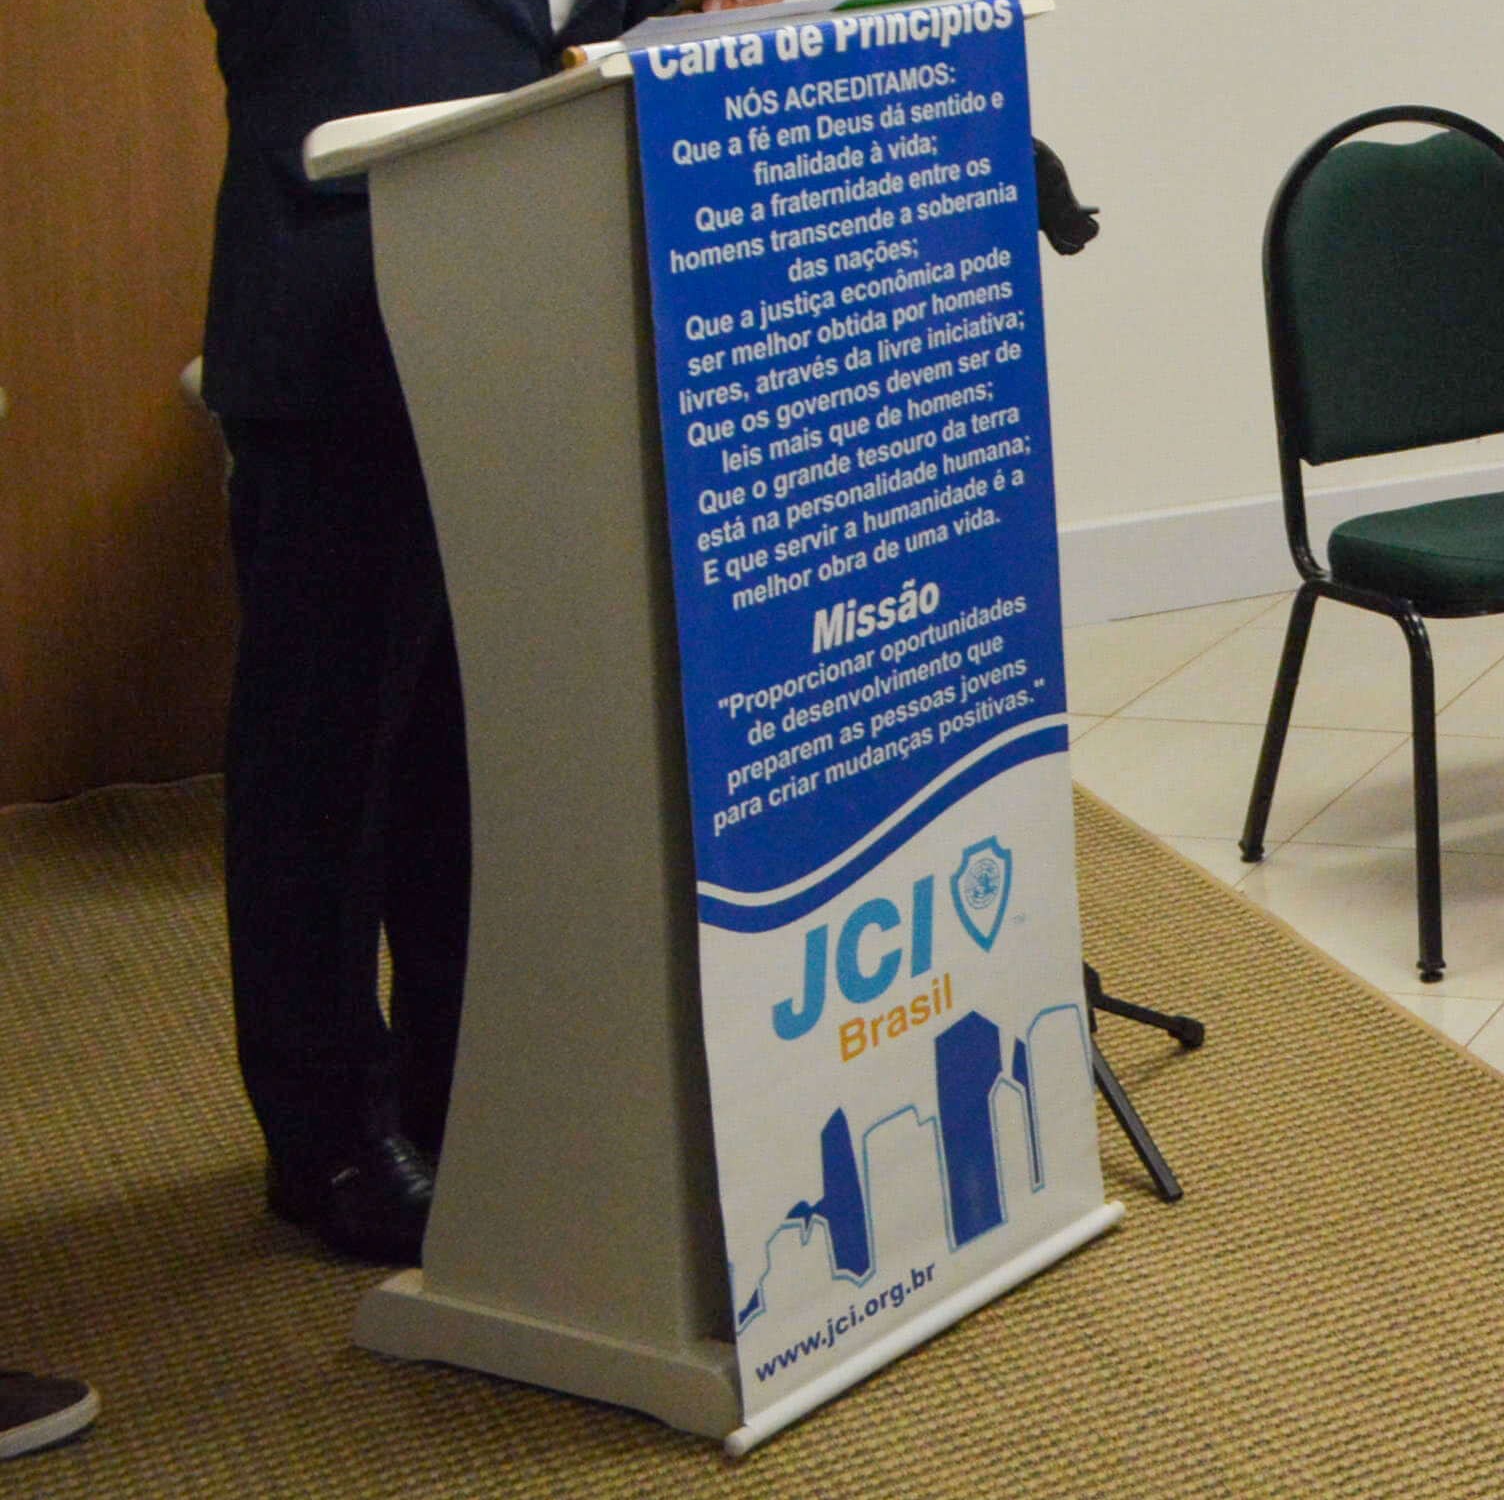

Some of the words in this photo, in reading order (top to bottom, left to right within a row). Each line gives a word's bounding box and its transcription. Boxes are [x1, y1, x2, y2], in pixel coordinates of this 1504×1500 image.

[650, 34, 764, 80] Carta
[776, 24, 823, 60] de
[725, 87, 779, 120] NÓS
[784, 62, 955, 111] ACREDITAMOS:
[672, 139, 721, 165] Que
[728, 136, 742, 156] a
[748, 125, 770, 152] fé
[777, 124, 811, 147] em
[816, 114, 875, 140] Deus
[880, 103, 906, 129] dá
[910, 90, 987, 123] sentido
[991, 91, 1004, 109] e
[753, 146, 864, 185] finalidade
[870, 141, 883, 164] à
[888, 133, 937, 160] vida;
[670, 237, 765, 274] homens
[770, 207, 895, 252] transcende
[900, 206, 913, 225] a
[916, 182, 1017, 221] soberania
[695, 206, 744, 232] Que
[751, 202, 765, 222] a
[770, 172, 904, 217] fraternidade
[908, 163, 961, 189] entre
[966, 157, 991, 177] os
[686, 314, 734, 341] Que
[740, 309, 754, 328] a
[760, 290, 835, 330] justiça
[841, 262, 955, 304] econômica
[960, 247, 1011, 282] pode
[788, 257, 828, 282] das
[834, 238, 919, 271] nações;
[679, 382, 749, 415] livres,
[756, 355, 838, 394] através
[844, 347, 872, 371] da
[878, 336, 922, 363] livre
[927, 310, 1024, 349] iniciativa;
[688, 350, 725, 376] ser
[732, 330, 811, 365] melhor
[817, 310, 887, 343] obtida
[892, 301, 927, 331] por
[931, 281, 1013, 315] homens
[687, 419, 735, 447] Que
[741, 410, 770, 432] os
[776, 380, 881, 429] governos
[886, 360, 953, 394] devem
[958, 350, 991, 373] ser
[995, 340, 1022, 363] de
[722, 444, 762, 473] leis
[769, 427, 823, 459] mais
[829, 417, 870, 446] que
[876, 405, 902, 429] de
[907, 382, 993, 420] homens;
[697, 515, 745, 552] está
[752, 511, 780, 533] na
[786, 461, 938, 529] personalidade
[943, 435, 1031, 474] humana;
[698, 486, 745, 515] Que
[752, 480, 767, 499] o
[773, 453, 851, 499] grande
[856, 430, 937, 469] tesouro
[941, 419, 966, 442] da
[971, 407, 1019, 434] terra
[703, 558, 719, 585] E
[725, 549, 768, 581] que
[774, 523, 838, 562] servir
[844, 521, 857, 539] a
[863, 477, 988, 534] humanidade
[993, 469, 1005, 491] é
[1011, 469, 1024, 486] a
[733, 568, 812, 610] melhor
[818, 551, 867, 581] obra
[873, 539, 900, 563] de
[905, 524, 949, 553] uma
[953, 507, 1000, 535] vida.
[812, 578, 940, 654] Missão
[880, 596, 1026, 663] oportunidades
[727, 733, 833, 795] preparem
[839, 722, 865, 745] as
[871, 686, 956, 737] pessoas
[960, 659, 1027, 703] jovens
[748, 720, 775, 745] de
[782, 651, 962, 733] desenvolvimento
[967, 635, 1003, 664] que
[713, 796, 762, 837] para
[768, 771, 819, 806] criar
[825, 727, 933, 784] mudanças
[772, 874, 935, 1041] JCI
[837, 973, 954, 1064] Brasil
[755, 1263, 935, 1382] www.jci.org.br
